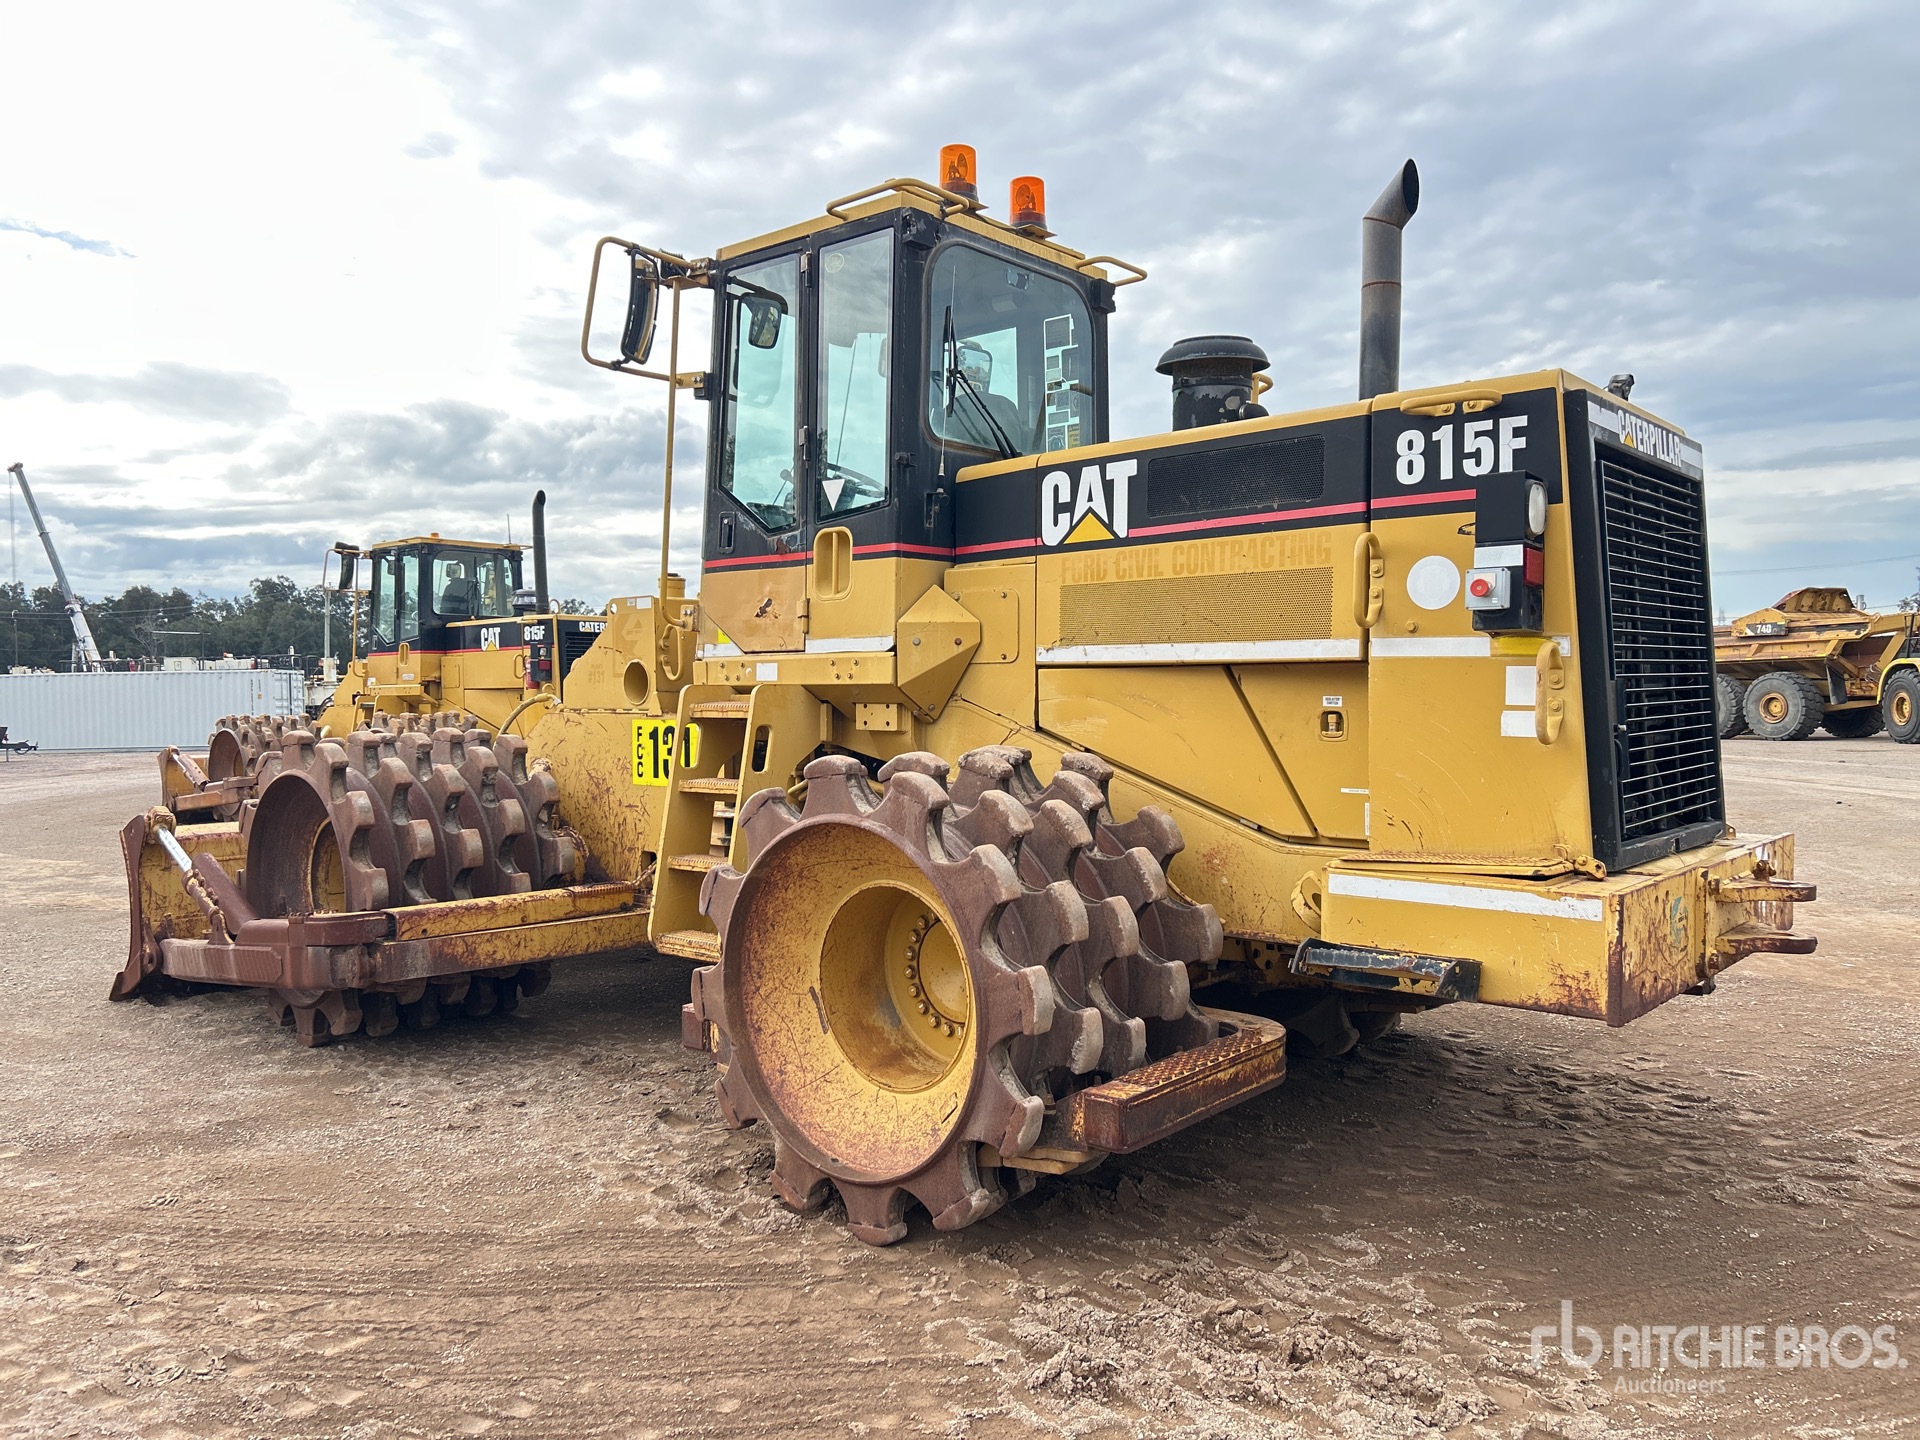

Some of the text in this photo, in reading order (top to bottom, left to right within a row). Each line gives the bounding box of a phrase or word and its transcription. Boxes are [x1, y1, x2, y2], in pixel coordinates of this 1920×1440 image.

[1396, 415, 1528, 485] 815F
[1617, 409, 1682, 468] CATERPILLAR
[1041, 458, 1138, 546] CAT
[1061, 530, 1333, 585] FORD CIVIL CONTRACTING
[480, 626, 501, 652] CAT
[523, 625, 546, 641] 815F
[1755, 624, 1772, 633] 740
[648, 725, 691, 779] 131
